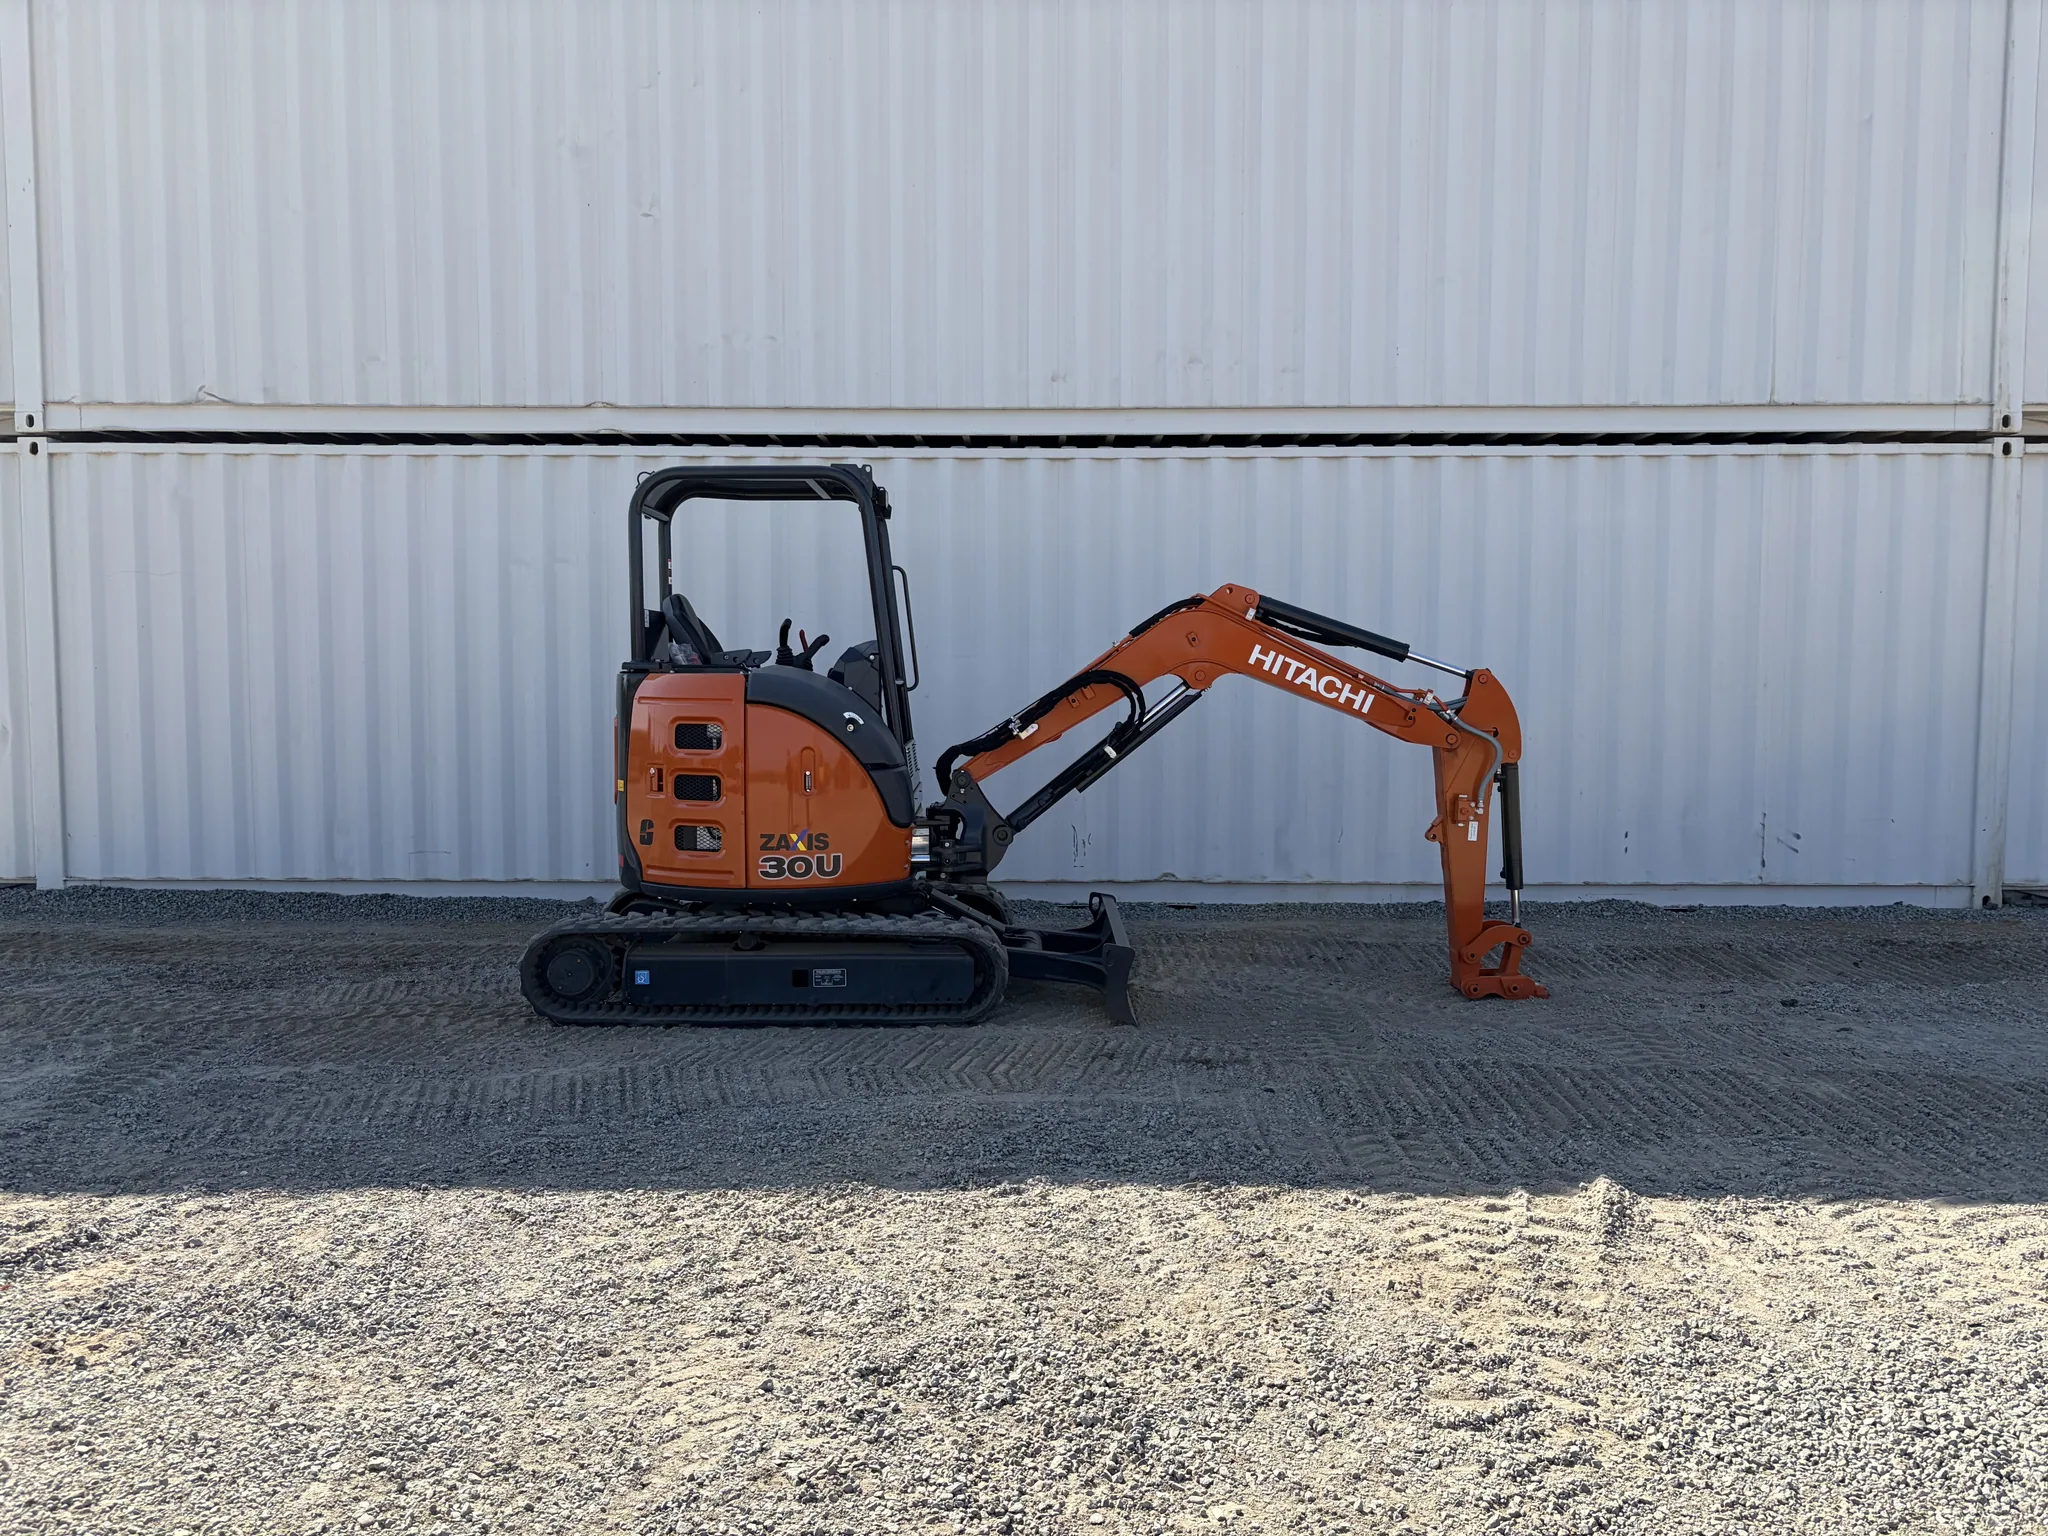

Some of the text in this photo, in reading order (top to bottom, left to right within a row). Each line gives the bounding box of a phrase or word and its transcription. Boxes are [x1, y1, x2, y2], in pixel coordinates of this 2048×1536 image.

[1248, 644, 1375, 714] HITACHI
[760, 829, 830, 851] ZAXIS
[758, 853, 842, 880] 30U
